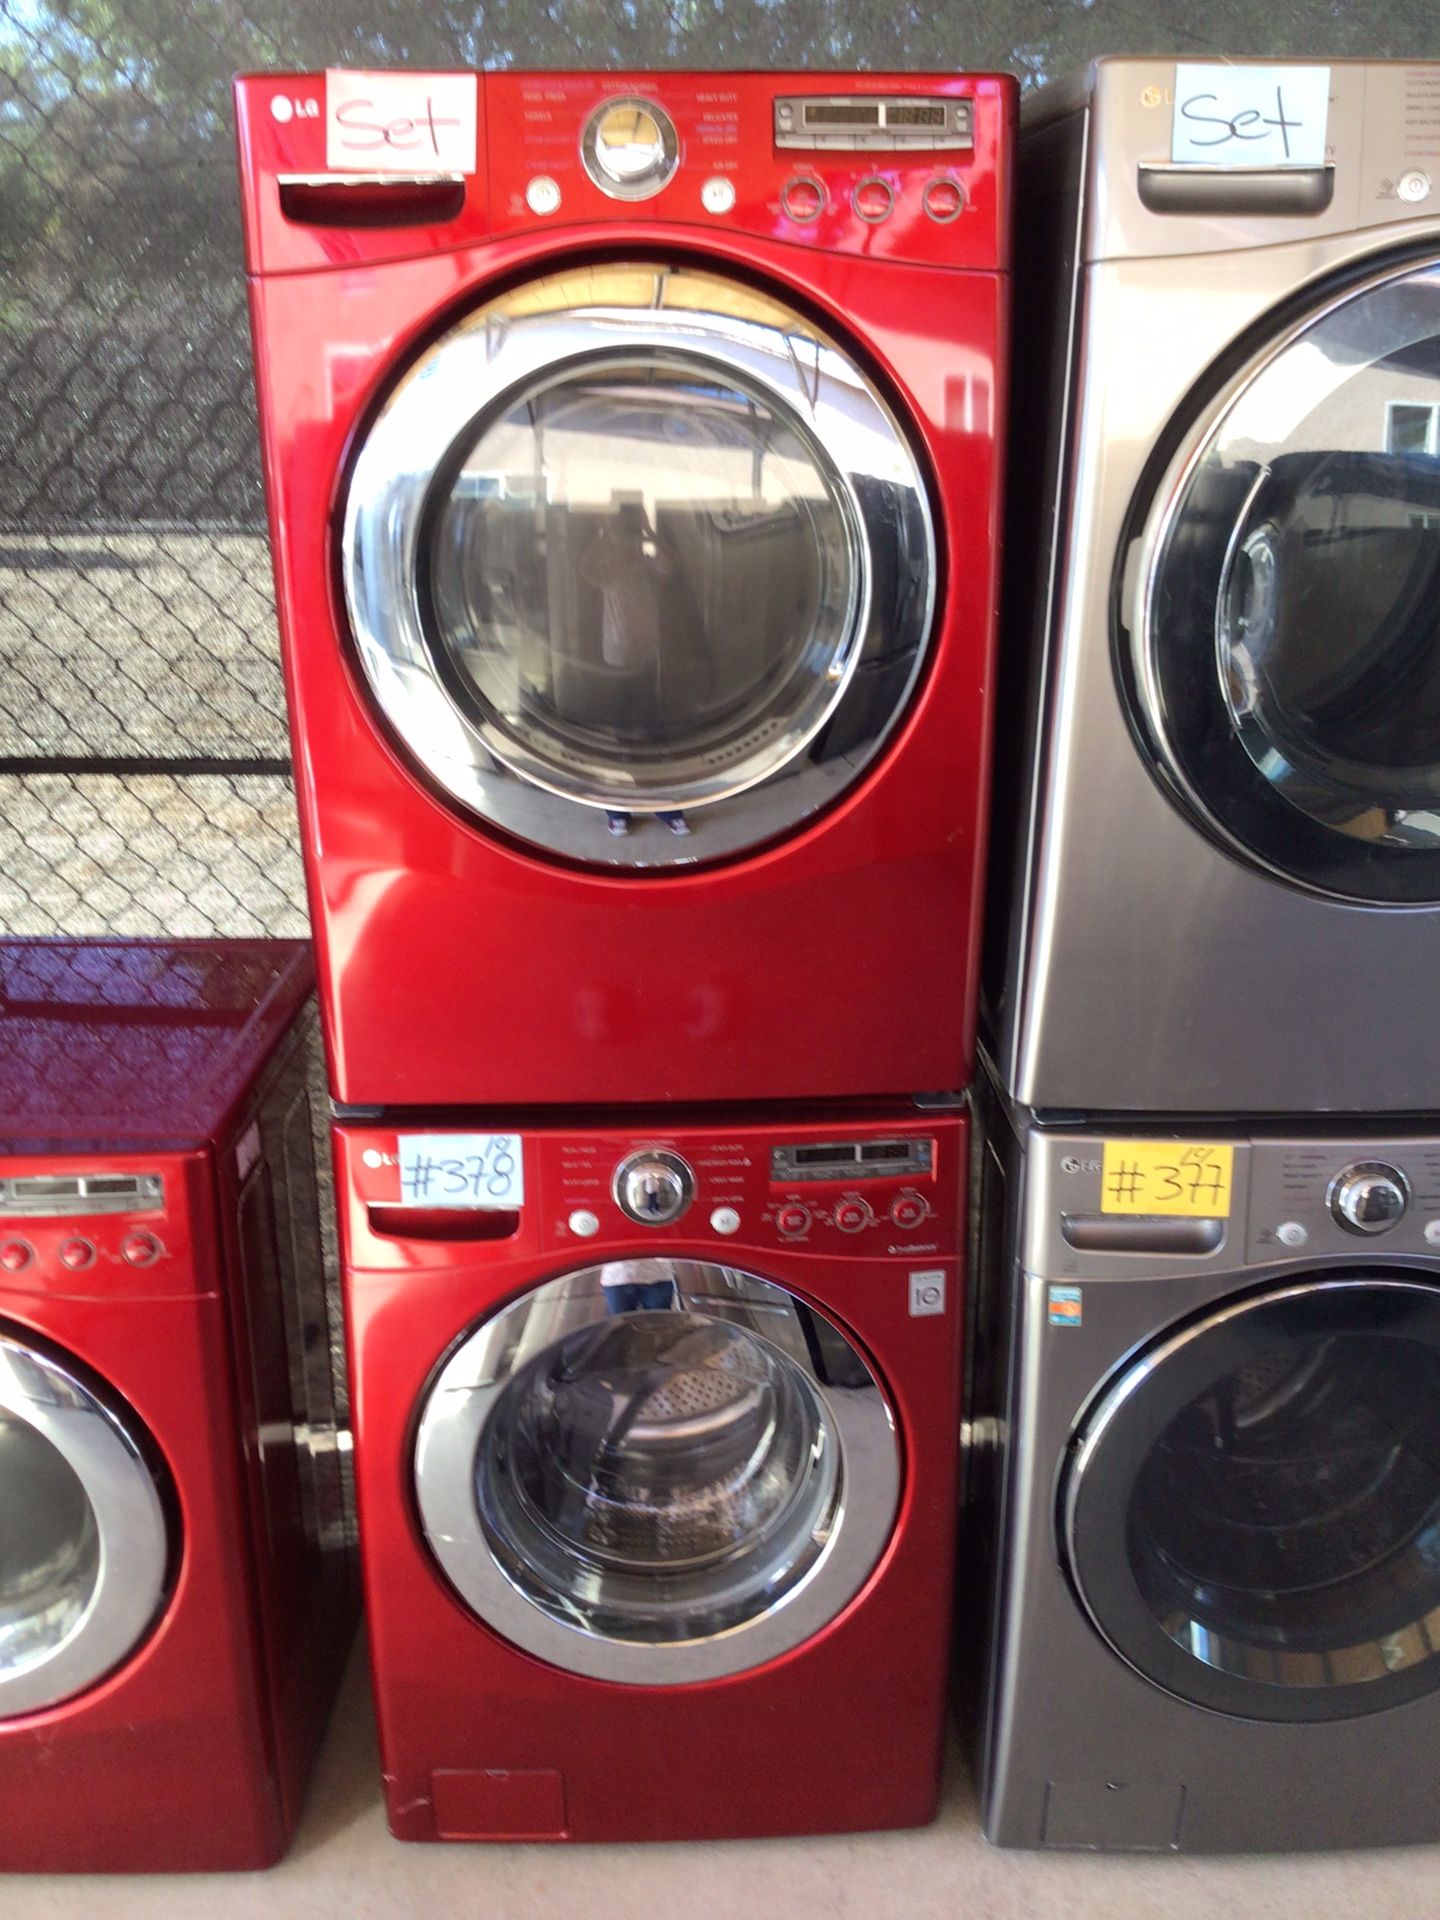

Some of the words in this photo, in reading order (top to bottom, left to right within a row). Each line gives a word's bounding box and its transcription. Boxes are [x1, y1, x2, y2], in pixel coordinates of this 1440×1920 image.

[293, 97, 320, 119] LG
[335, 96, 461, 157] Set
[1181, 85, 1303, 158] Set
[401, 1152, 515, 1199] #378
